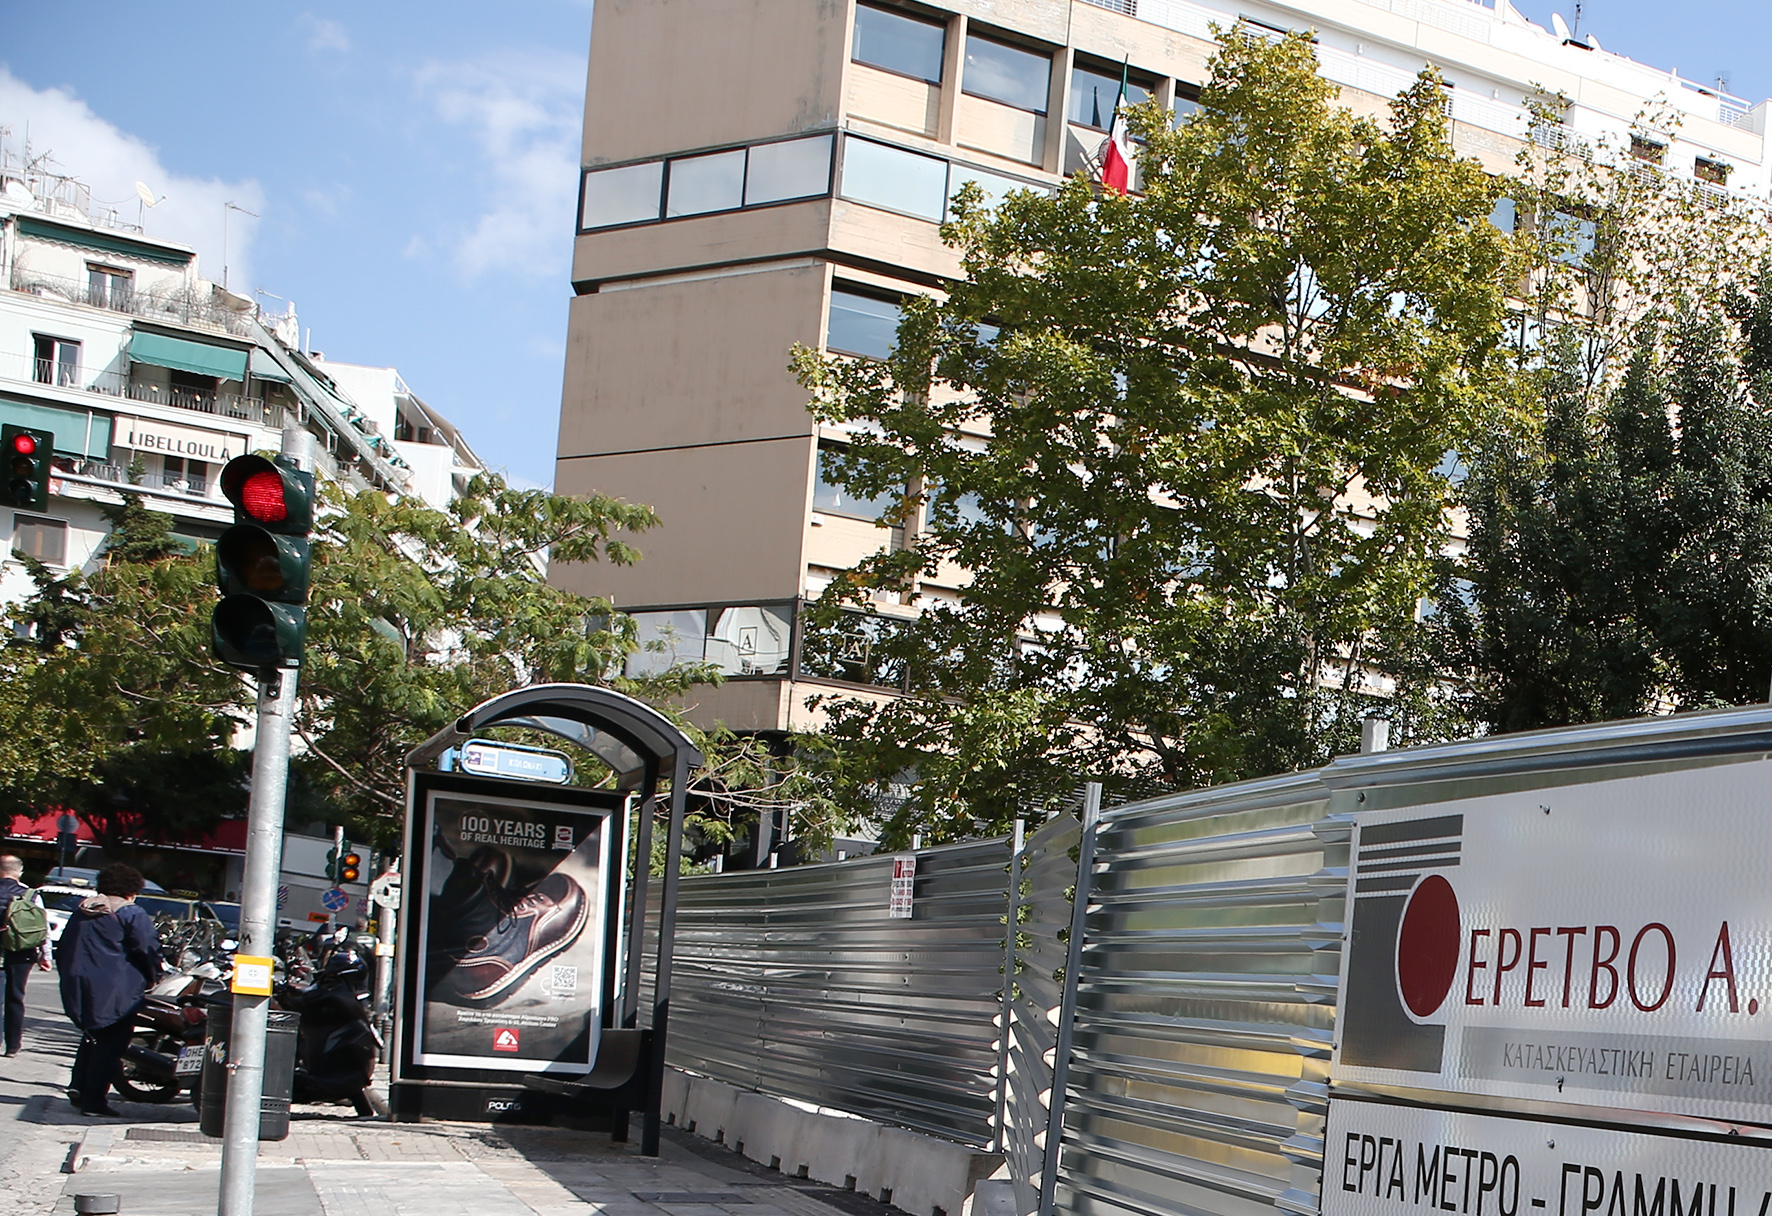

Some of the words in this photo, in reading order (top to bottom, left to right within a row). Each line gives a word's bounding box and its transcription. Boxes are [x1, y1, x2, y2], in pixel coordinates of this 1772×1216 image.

[128, 432, 230, 460] LIBELLOULA
[460, 831, 473, 841] OF
[474, 833, 499, 844] REAL
[500, 836, 546, 849] HERITAGE
[462, 816, 490, 833] 100
[493, 819, 546, 839] YEARS
[1465, 922, 1677, 1013] ΕΡΕΤΒΟ
[1503, 1043, 1654, 1079] ΚΑΤΑΣΚΕΥΑΣΤΙΚΗ
[1666, 1053, 1755, 1087] ΕΤΑΙΡΕΙΑ
[1342, 1132, 1405, 1202] ΕΡΓΑ
